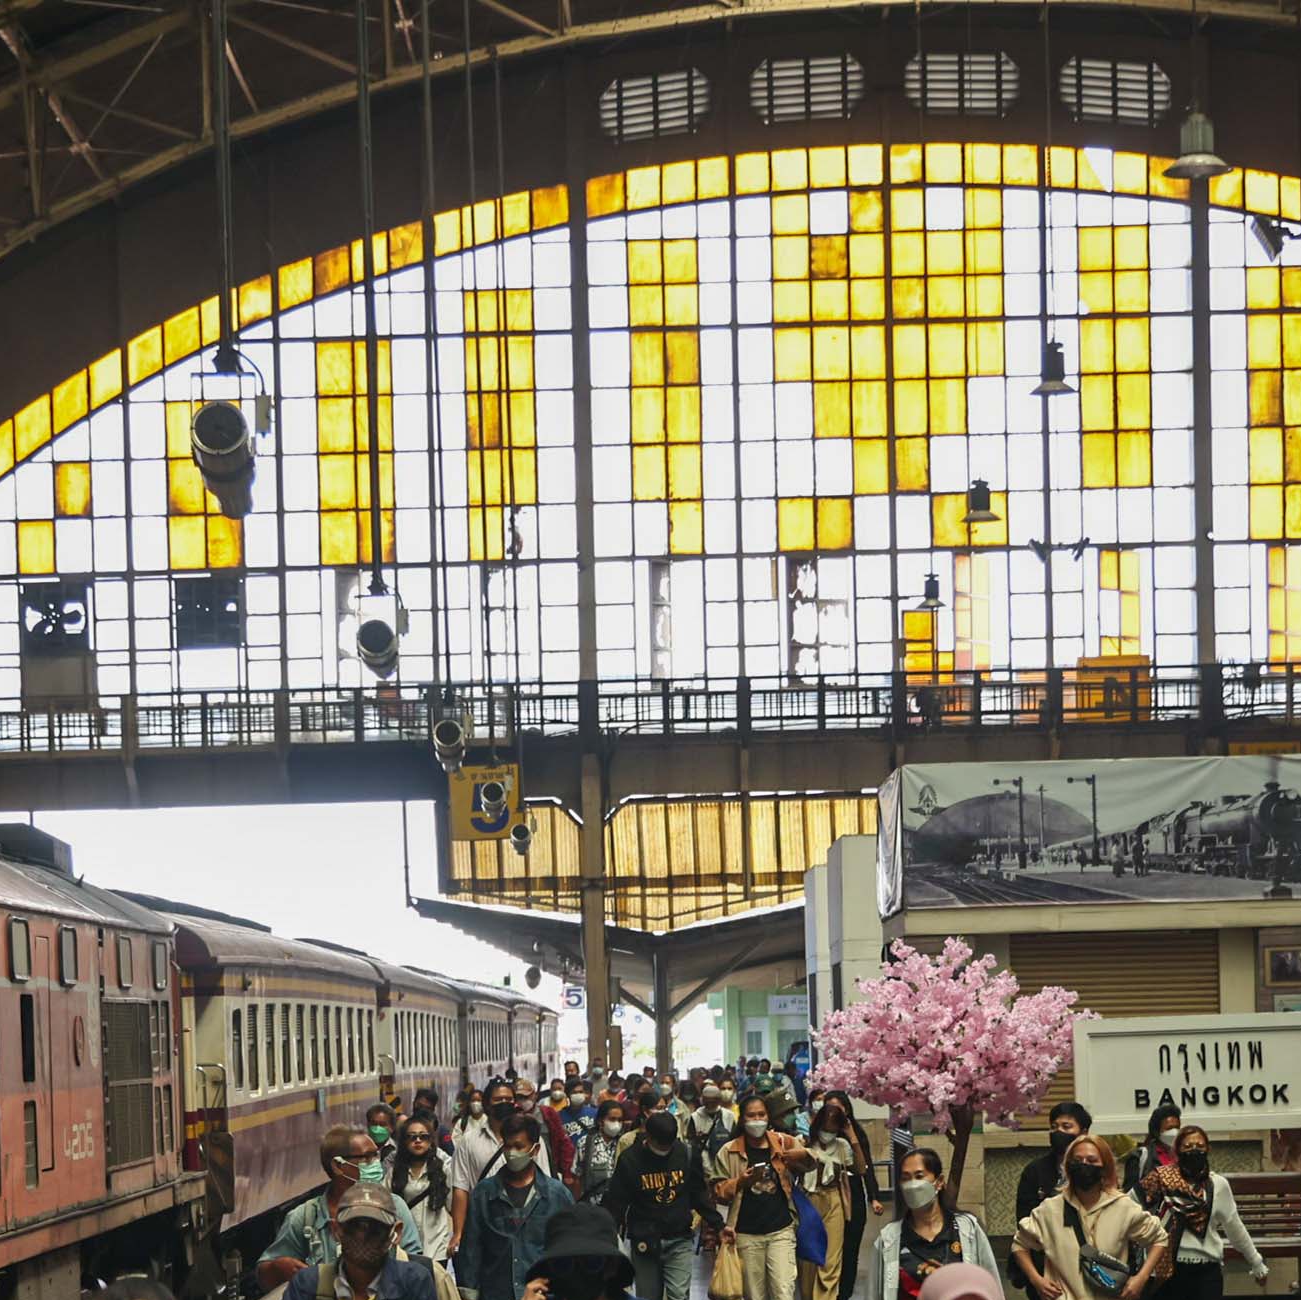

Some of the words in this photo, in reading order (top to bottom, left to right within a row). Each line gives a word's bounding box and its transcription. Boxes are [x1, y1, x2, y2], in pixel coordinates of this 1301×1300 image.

[566, 988, 582, 1006] 5
[1158, 1040, 1264, 1085] กรุงเทพ
[1134, 1083, 1290, 1109] BANGKOK
